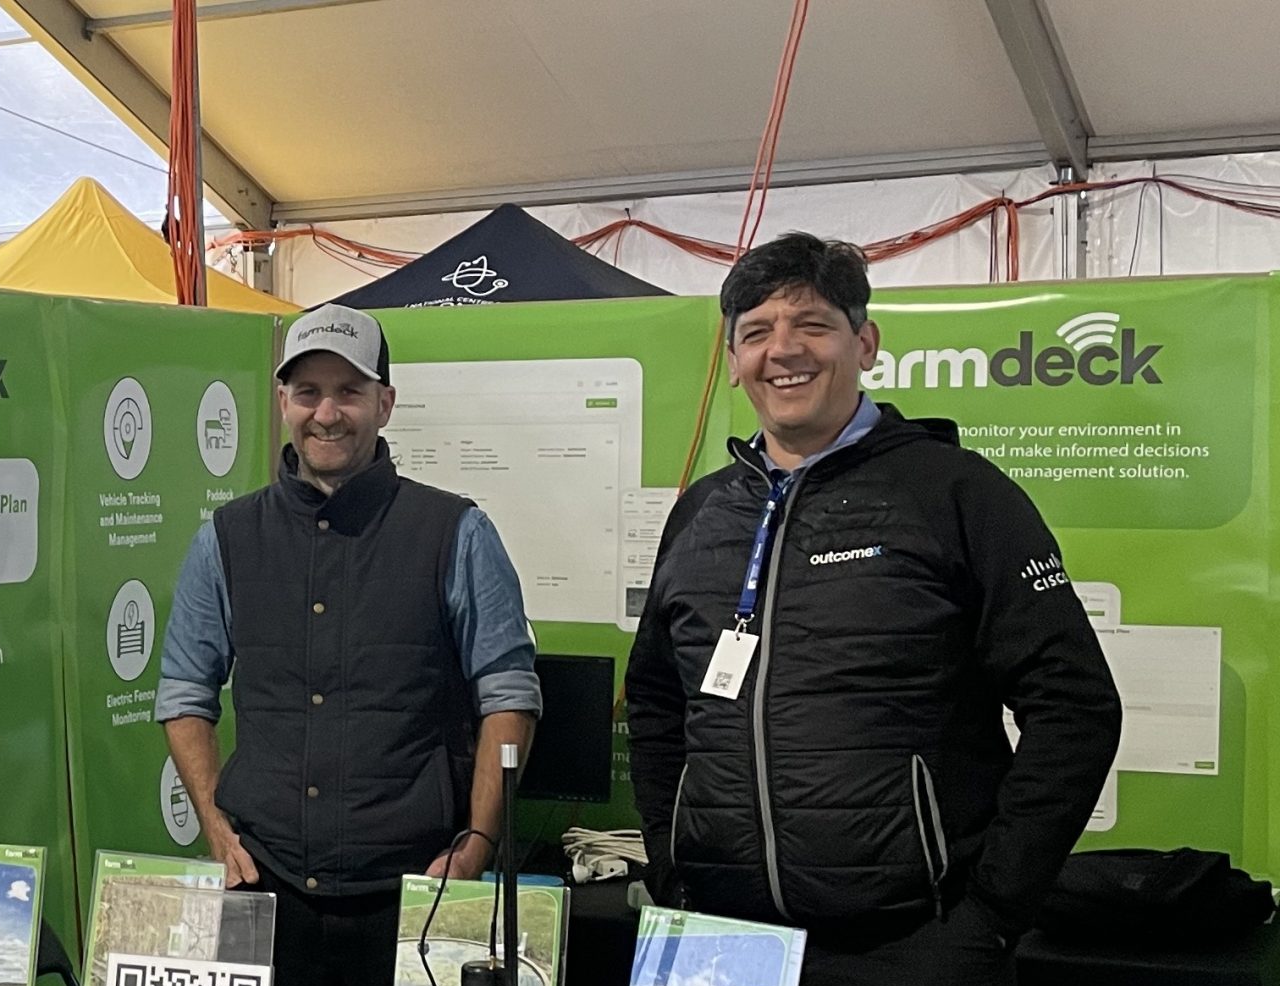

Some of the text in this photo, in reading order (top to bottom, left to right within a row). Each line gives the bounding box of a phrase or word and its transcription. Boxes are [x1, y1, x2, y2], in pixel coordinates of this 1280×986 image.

[860, 328, 1163, 389] armdeck
[958, 423, 1180, 439] monitor your environment in
[1010, 444, 1052, 457] make
[1057, 443, 1128, 456] informed
[1134, 444, 1209, 457] decisions
[1009, 464, 1189, 481] management solution.
[1, 495, 27, 513] Plan
[100, 492, 160, 506] Vehicle Tracking
[100, 514, 114, 526] and
[810, 545, 881, 565] outcomex
